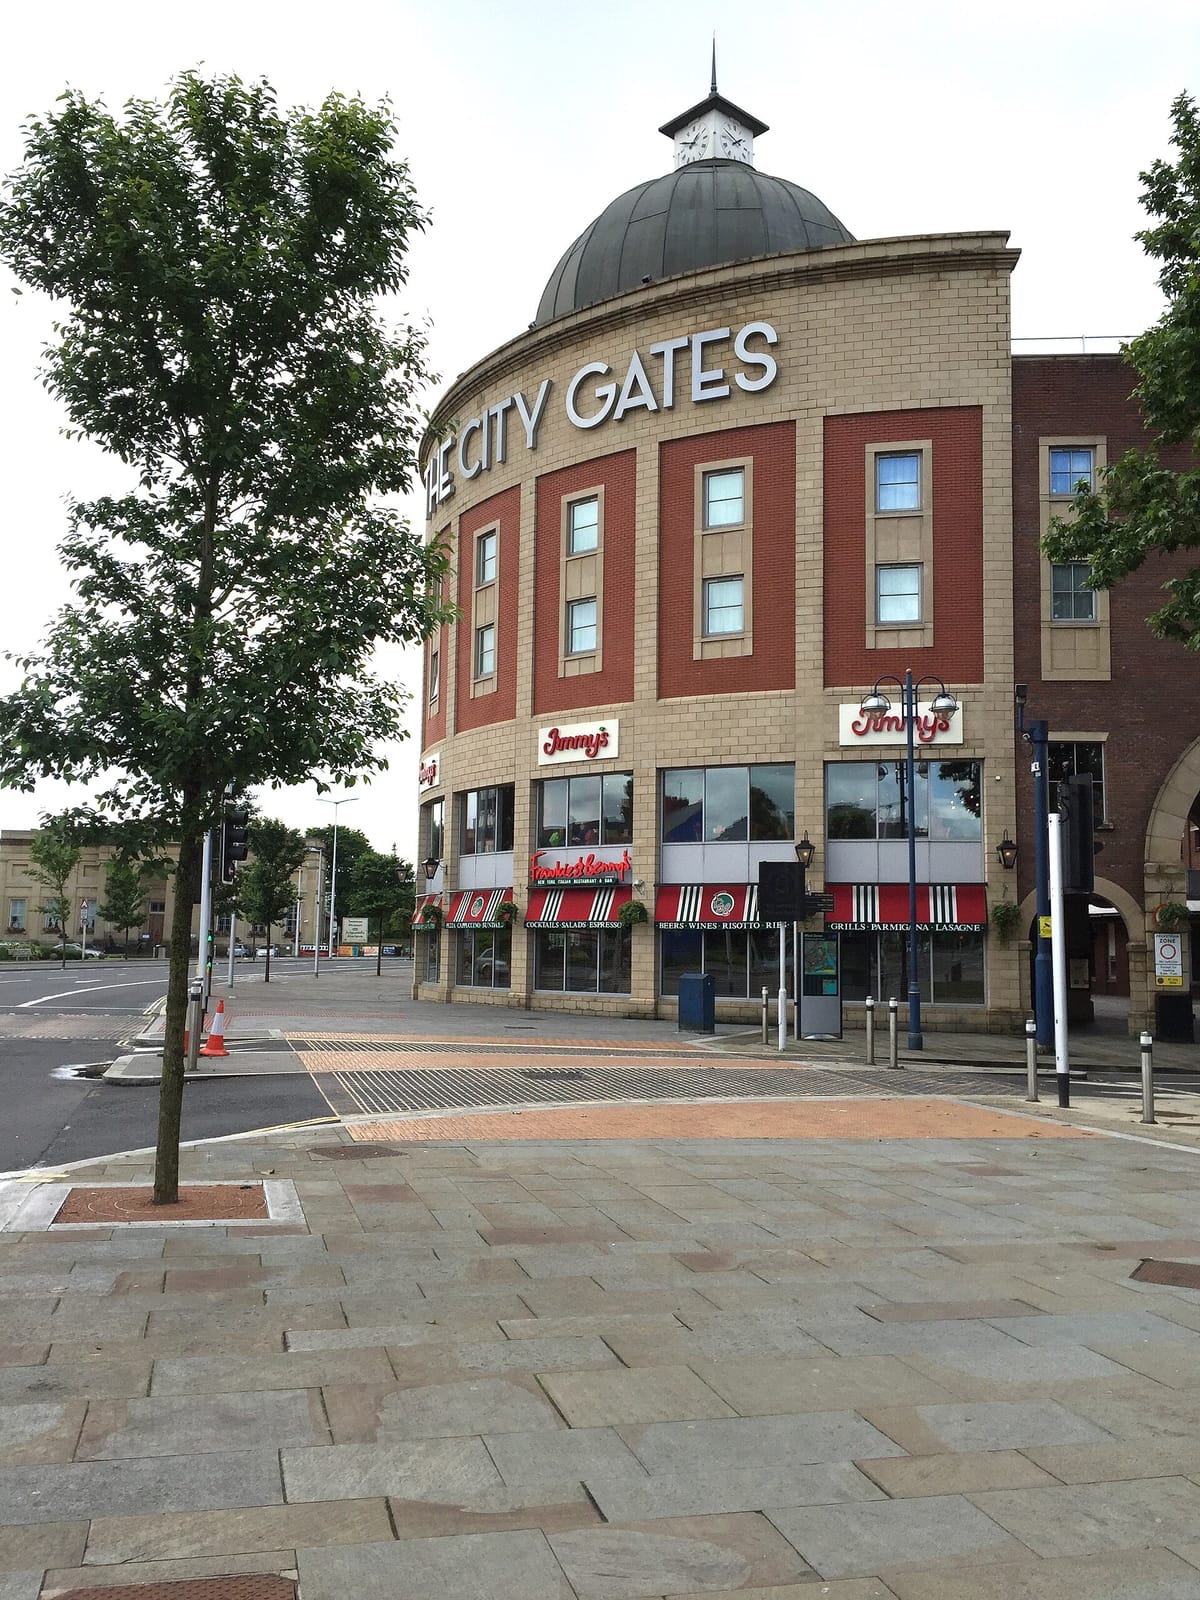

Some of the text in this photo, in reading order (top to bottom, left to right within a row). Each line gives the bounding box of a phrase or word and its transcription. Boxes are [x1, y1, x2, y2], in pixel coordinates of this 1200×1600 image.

[458, 379, 553, 480] CITY
[565, 322, 779, 430] GATES
[852, 706, 950, 742] Jimmys
[543, 727, 609, 758] Jimmy's
[530, 850, 575, 882] Frankie
[526, 921, 622, 929] COCKTAILS SALADS ESPRESSO
[659, 922, 685, 930] BEERS
[688, 922, 717, 930] WINES
[722, 921, 760, 930] RISOTTO
[830, 923, 866, 931] GRILLS
[935, 924, 981, 932] LASAGNE
